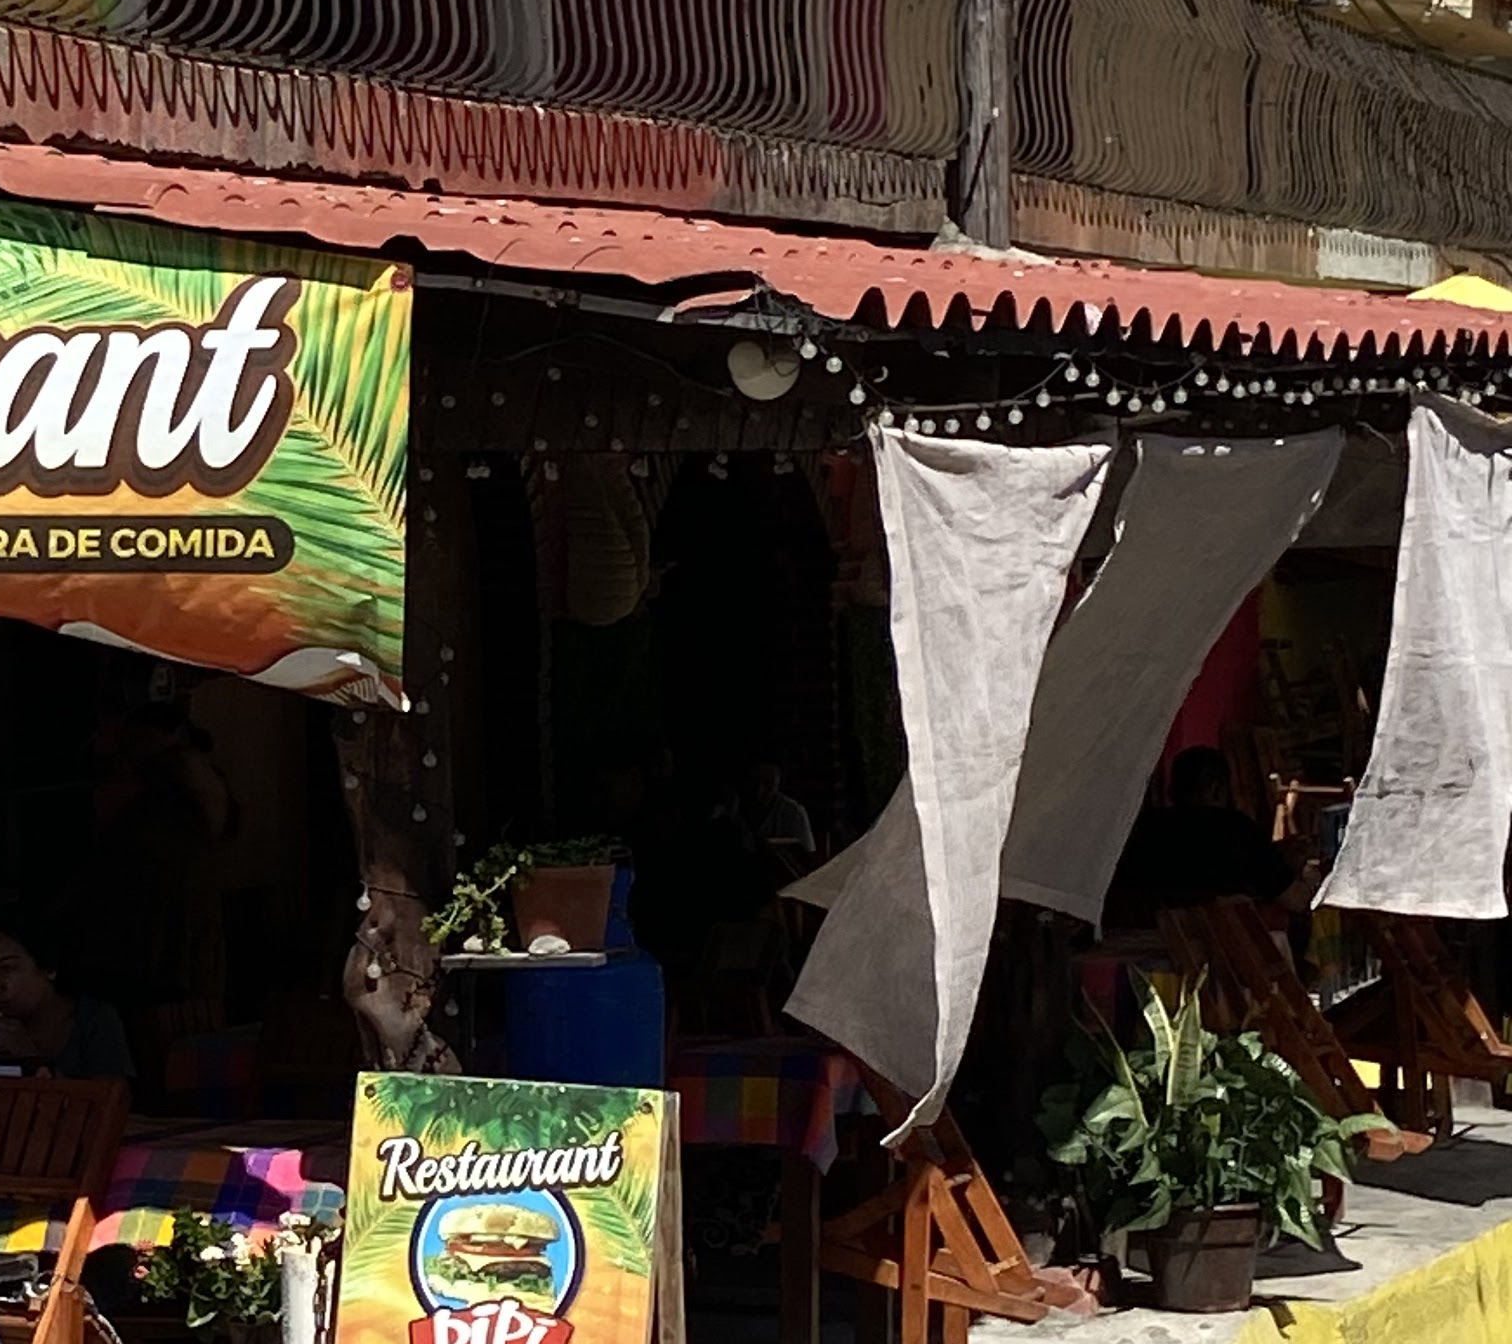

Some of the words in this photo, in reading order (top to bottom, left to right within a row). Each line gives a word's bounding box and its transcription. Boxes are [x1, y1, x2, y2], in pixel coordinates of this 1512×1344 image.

[47, 528, 106, 560] DE
[110, 528, 275, 560] COMIDA
[379, 1131, 622, 1197] Restaurant
